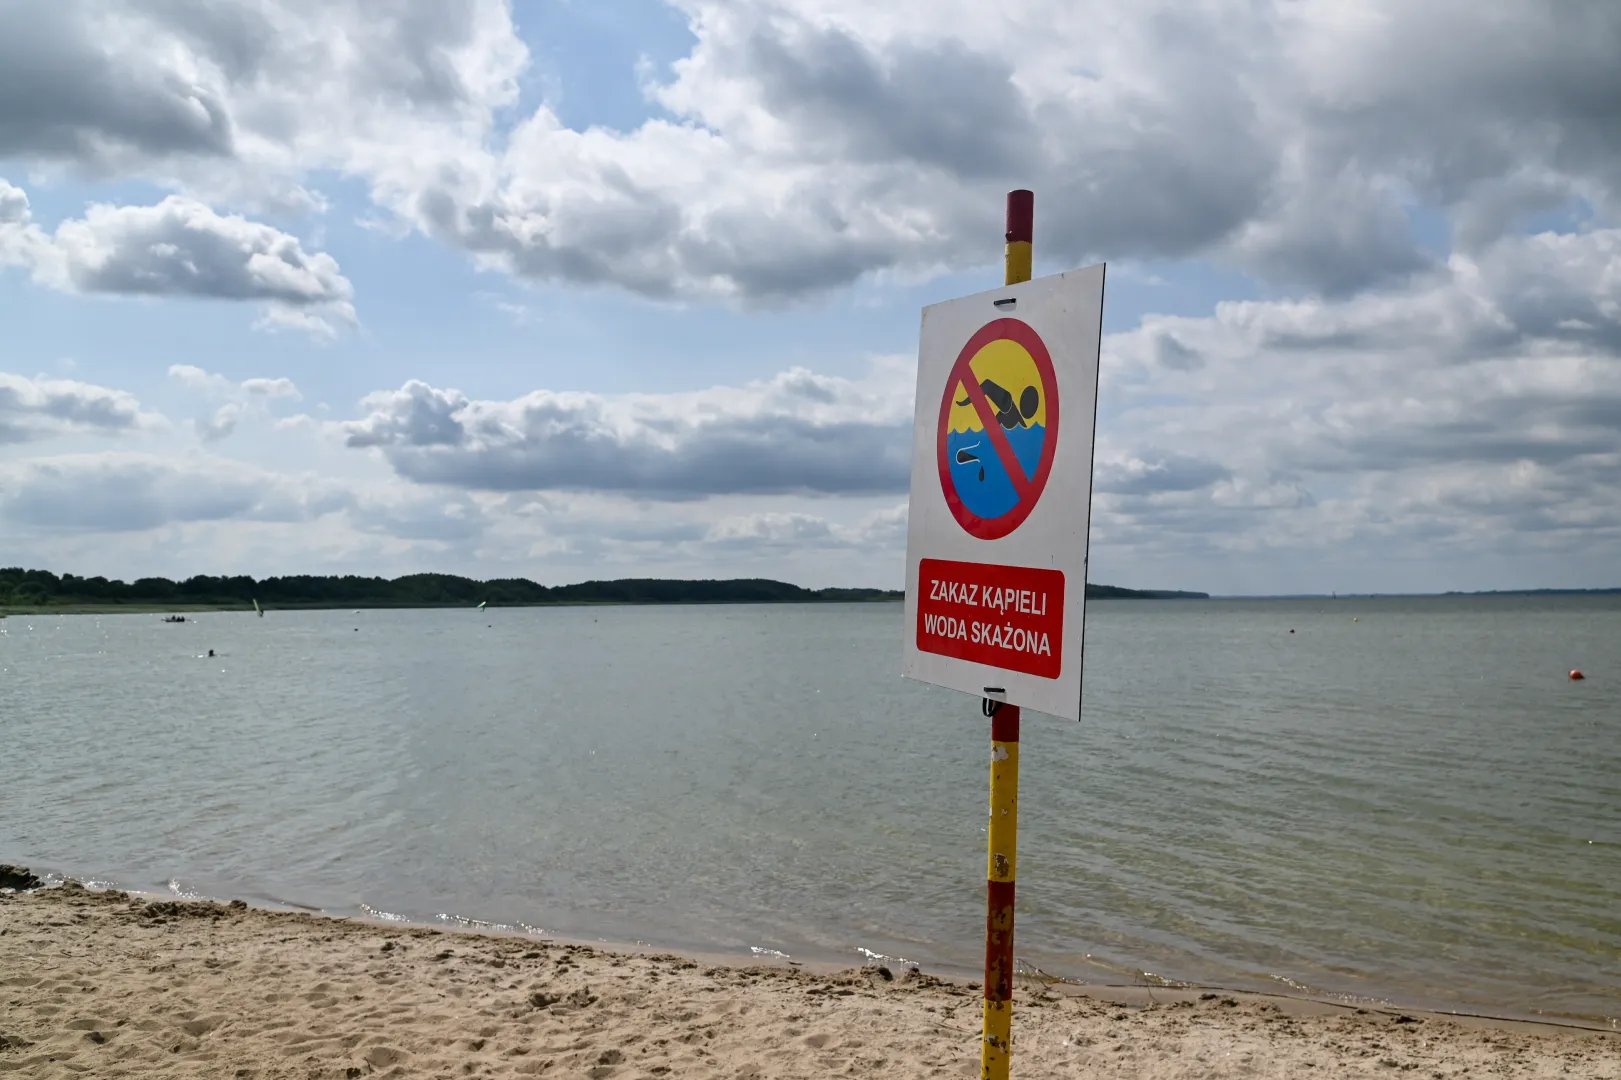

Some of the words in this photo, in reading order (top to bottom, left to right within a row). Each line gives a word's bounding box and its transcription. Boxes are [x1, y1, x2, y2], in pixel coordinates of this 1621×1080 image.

[930, 579, 979, 606] ZAKAZ
[982, 585, 1047, 616] KĄPIELI
[924, 613, 968, 641] WODA
[971, 621, 1051, 657] SKAŻONA
